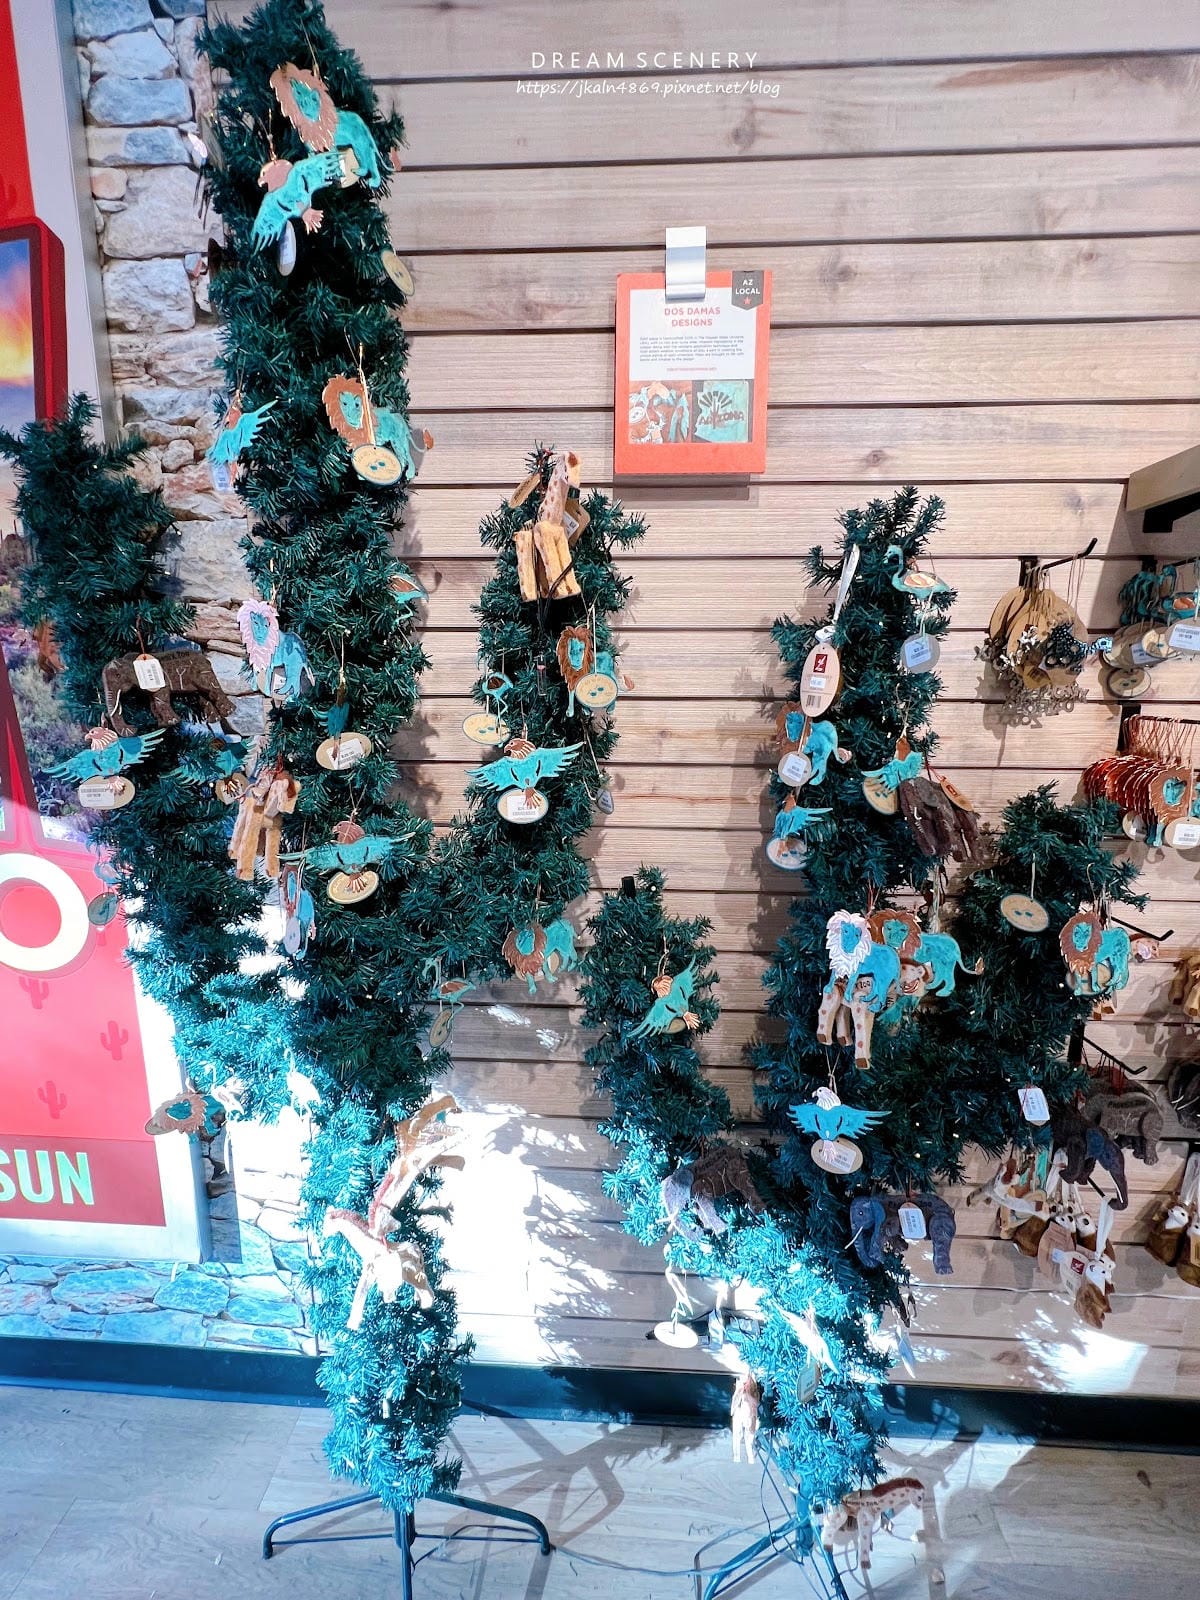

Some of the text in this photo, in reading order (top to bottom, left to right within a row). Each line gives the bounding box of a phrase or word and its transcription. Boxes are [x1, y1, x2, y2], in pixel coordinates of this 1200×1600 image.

[735, 287, 761, 295] LOCAL
[664, 306, 721, 316] DOS DAMAS
[671, 318, 713, 327] DESIGNS
